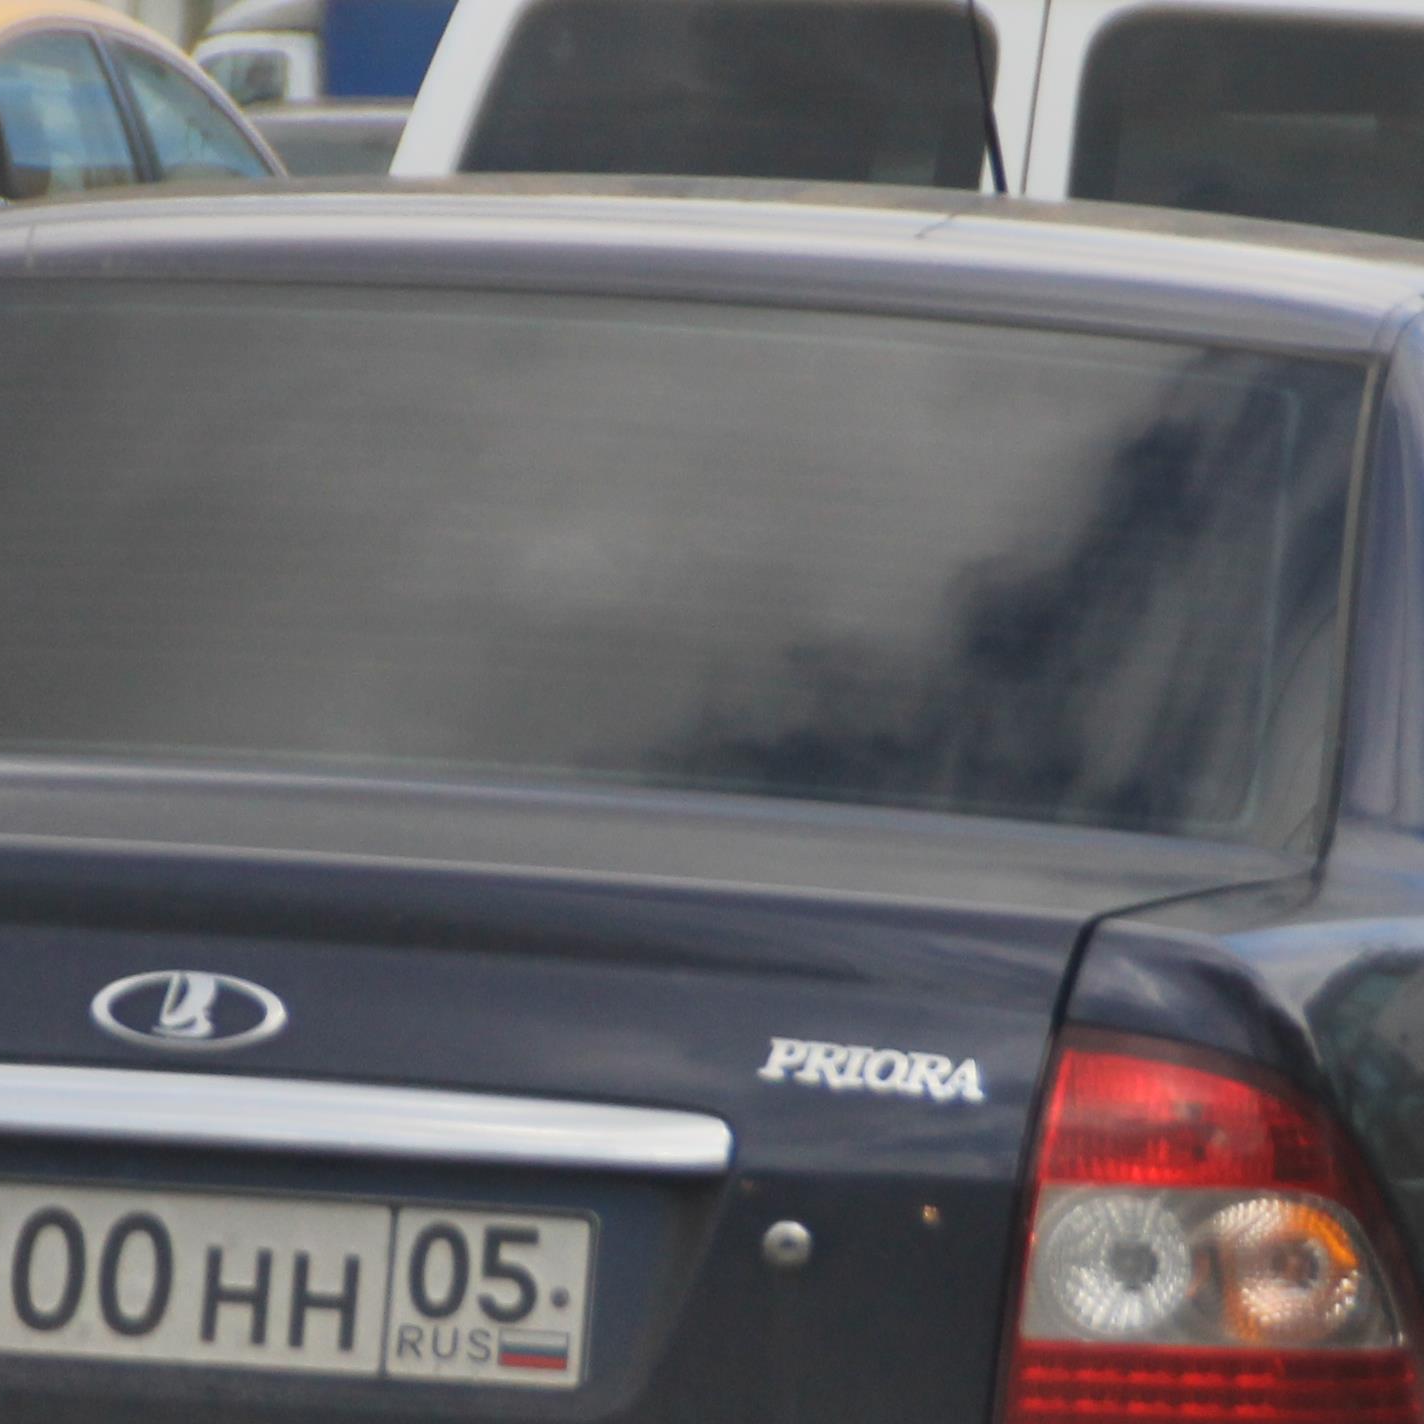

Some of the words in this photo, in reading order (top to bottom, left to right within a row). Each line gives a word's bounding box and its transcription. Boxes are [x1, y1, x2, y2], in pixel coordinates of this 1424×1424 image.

[758, 1037, 984, 1103] PRIORA
[407, 1222, 539, 1323] 05
[396, 1324, 491, 1363] RUS
